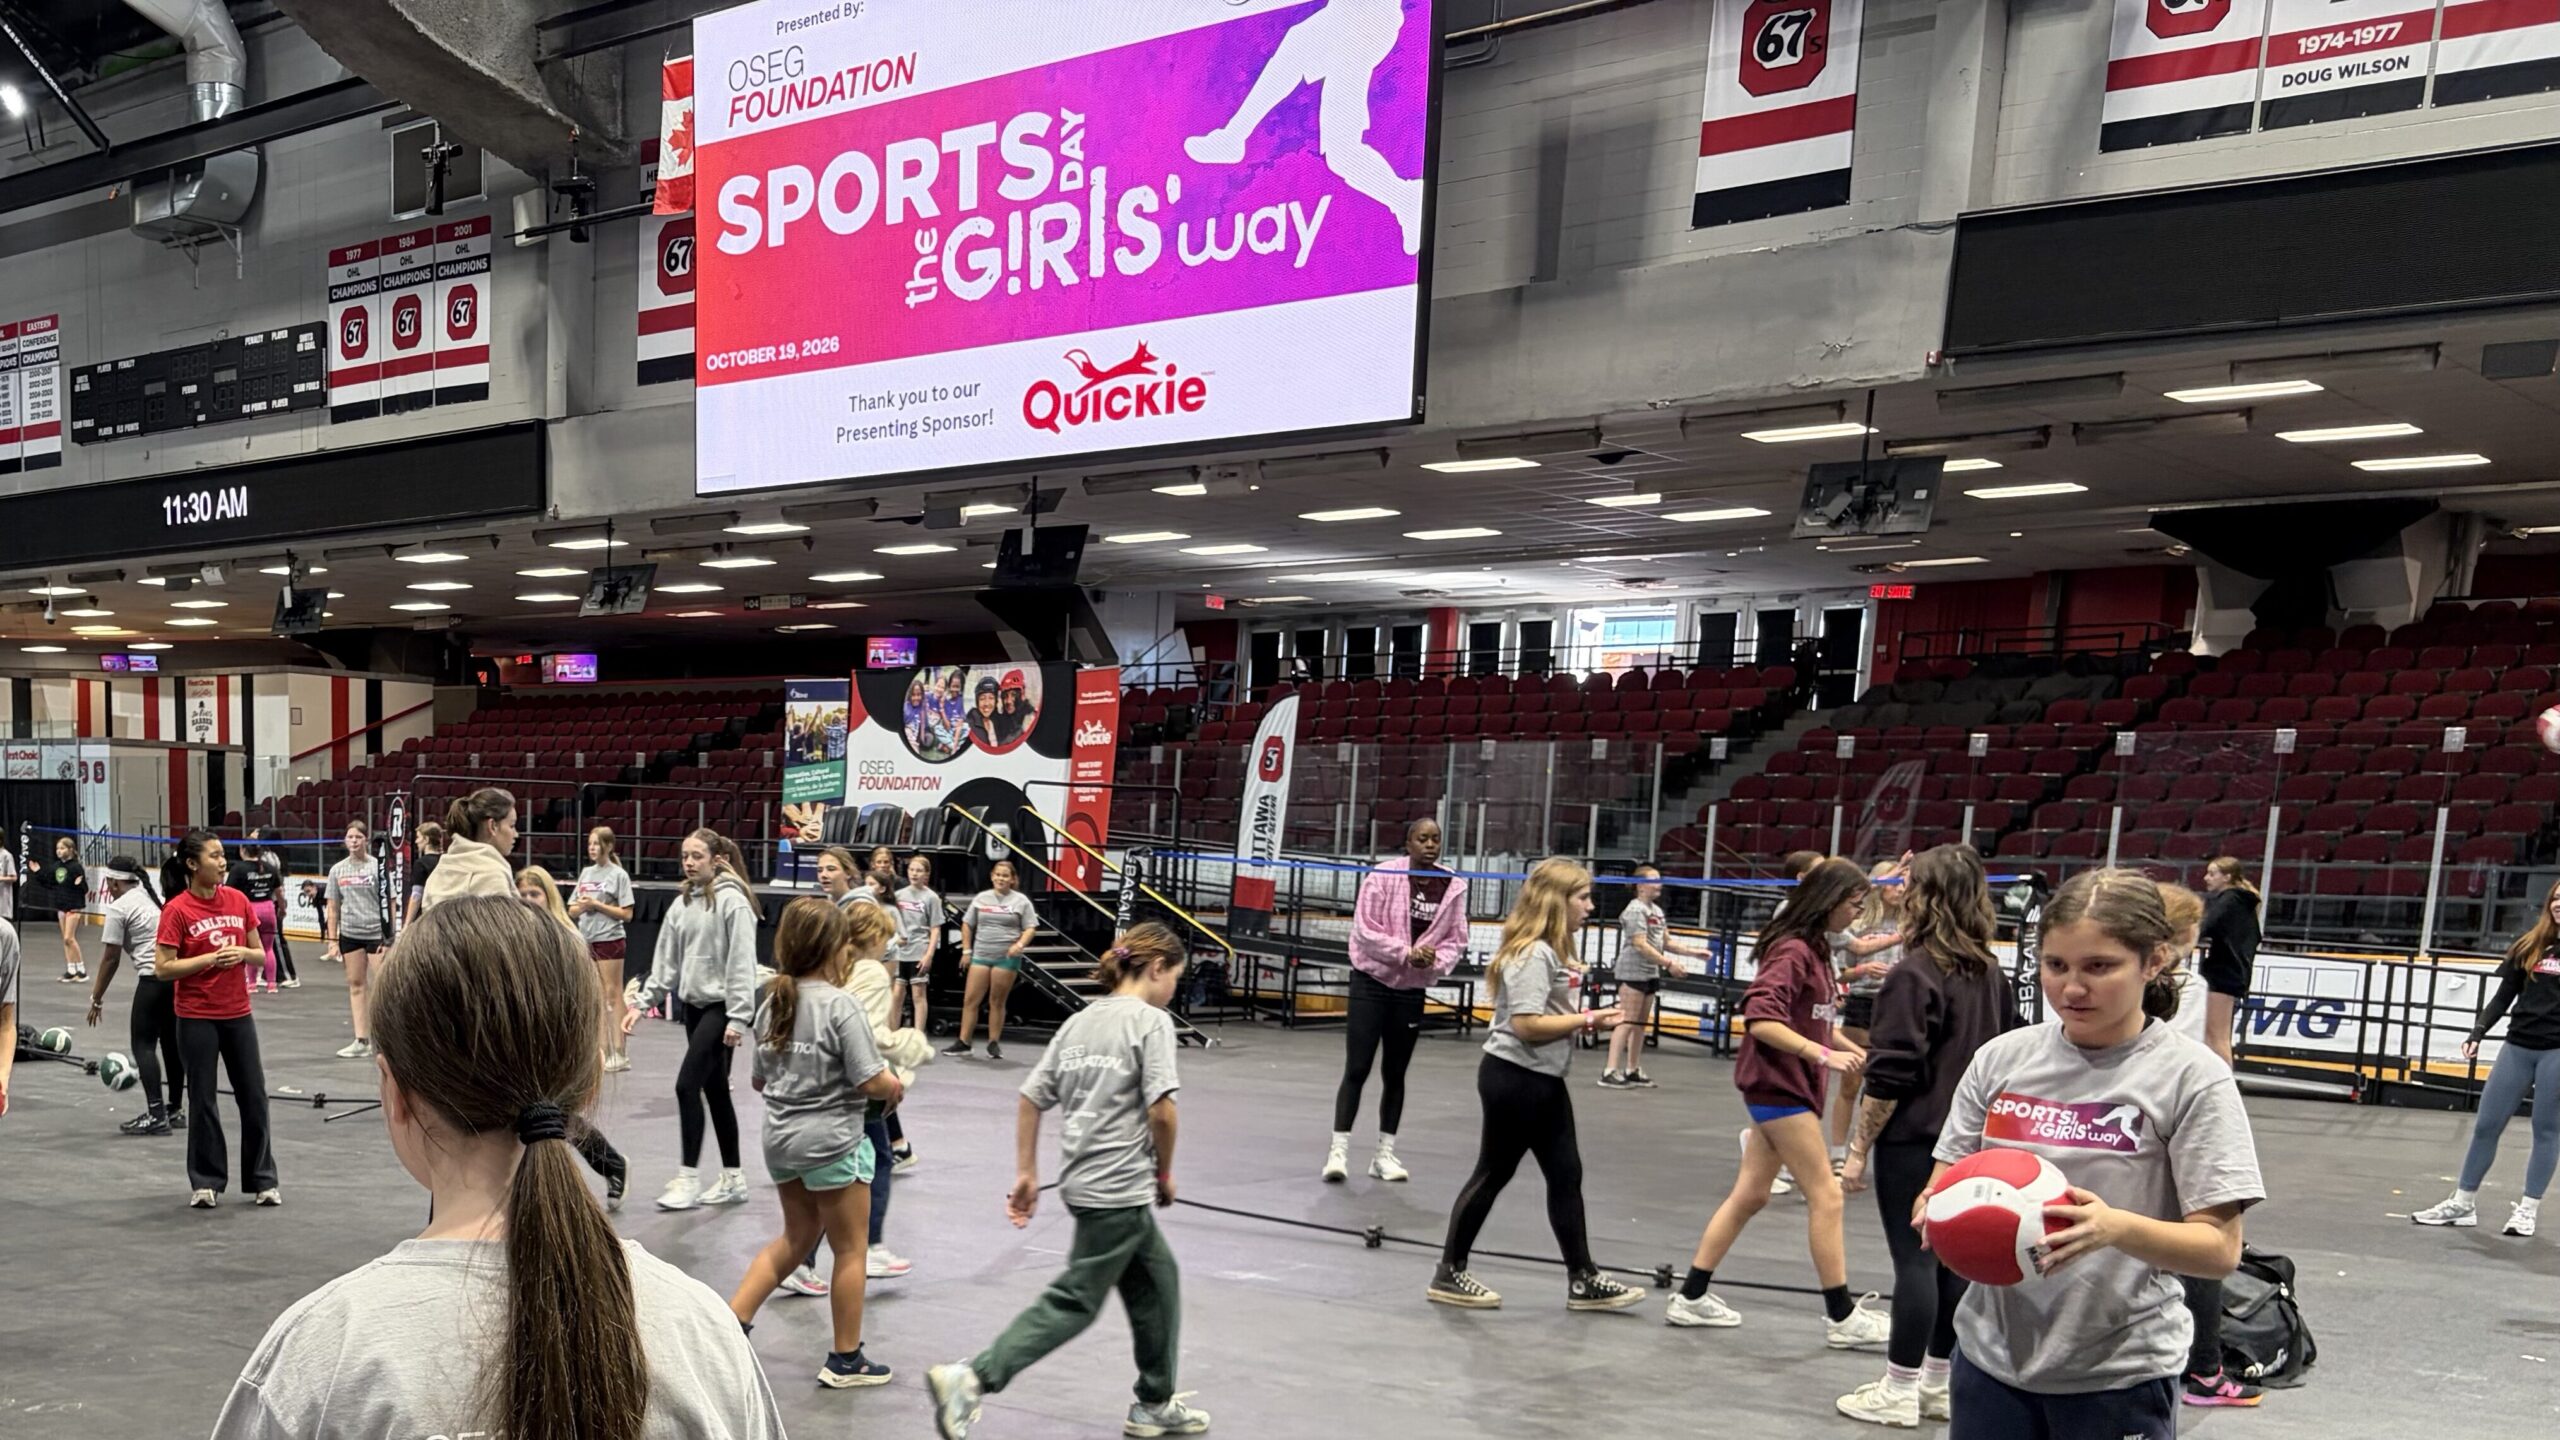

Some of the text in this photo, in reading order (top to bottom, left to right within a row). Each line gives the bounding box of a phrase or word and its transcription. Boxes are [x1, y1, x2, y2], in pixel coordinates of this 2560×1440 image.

[777, 1, 864, 35] Presented By:
[2298, 21, 2403, 55] 1974-1977
[728, 45, 804, 92] OSEG
[2281, 55, 2410, 89] DOUG WILSON
[728, 52, 917, 128] FOUNDATION
[717, 106, 1086, 256] SPORTS DAY
[454, 224, 473, 237] 2001
[455, 244, 471, 255] OHL
[905, 227, 938, 309] the
[1177, 194, 1332, 268] way
[399, 255, 414, 267] OHL
[437, 257, 488, 277] CHAMPIONS
[383, 268, 432, 289] CHAMPIONS
[331, 280, 377, 300] CHAMPIONS
[27, 319, 51, 332] EASTERN
[22, 333, 57, 348] CONFERENCE
[22, 348, 58, 364] CHAMPIONS
[706, 336, 840, 371] OCTOBER 19, 2026
[849, 381, 981, 412] Thank you to our
[836, 408, 994, 443] Presenting Sponsor!
[163, 485, 247, 526] 11:30 AM
[859, 760, 894, 775] OSEG
[858, 776, 941, 790] FOUNDATION
[189, 915, 245, 937] CARLETON
[1991, 1098, 2072, 1125] SPORTS
[2088, 1131, 2123, 1146] way
